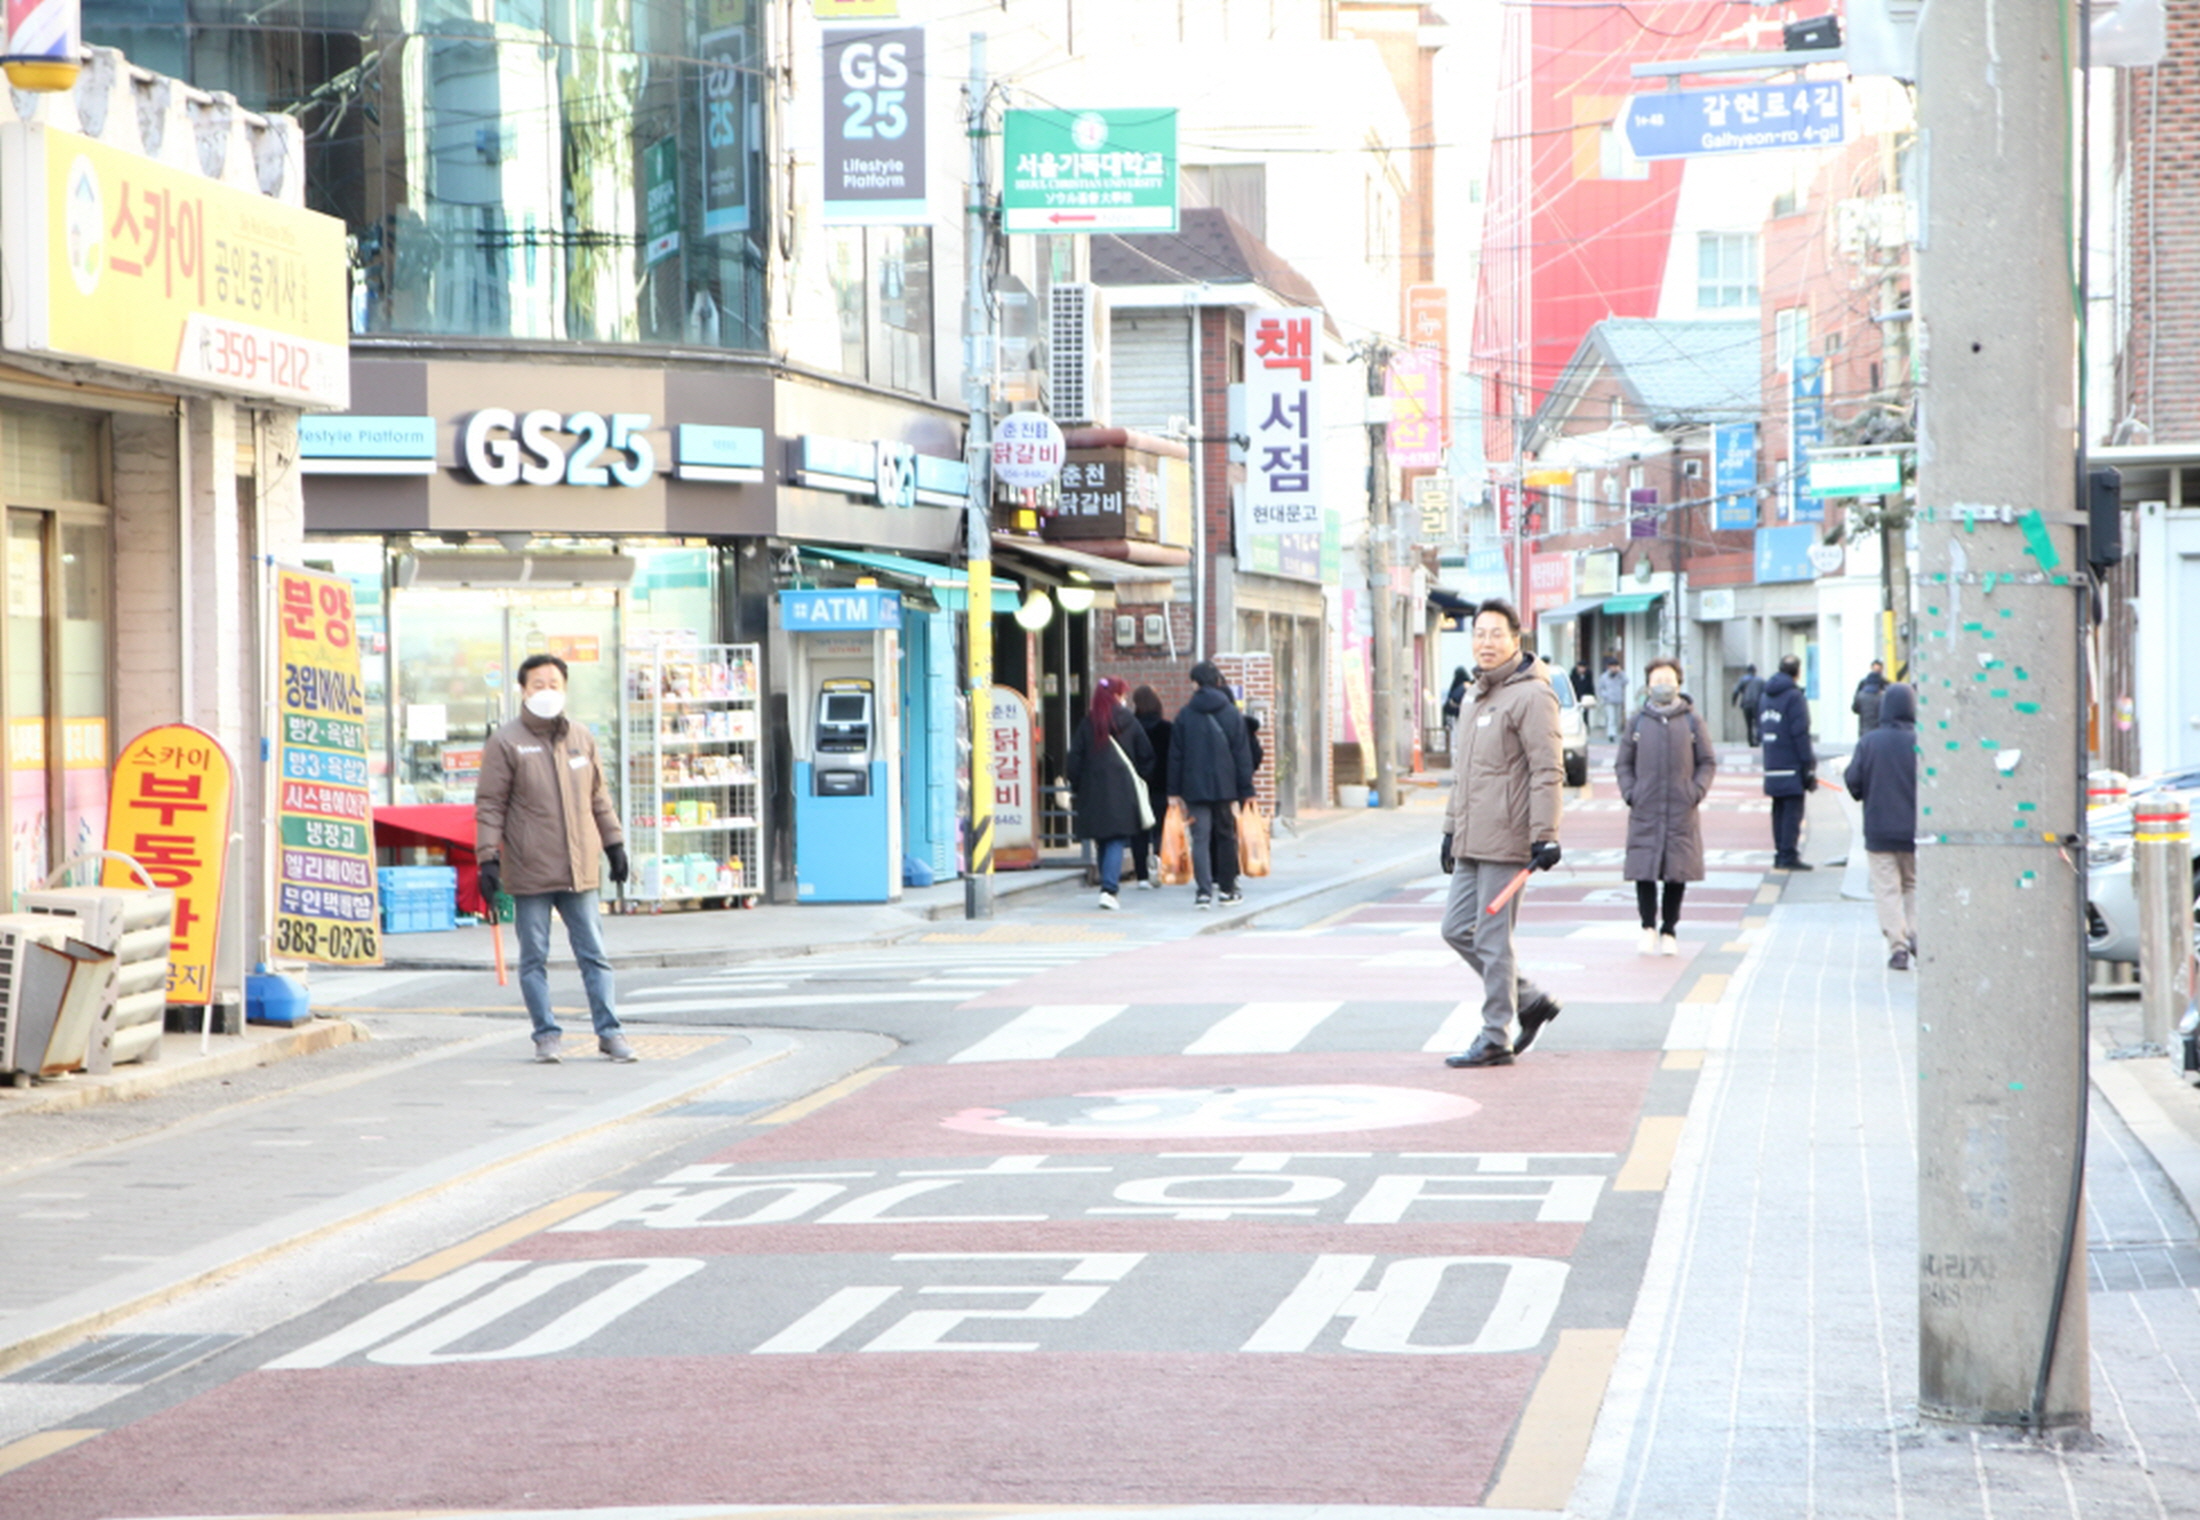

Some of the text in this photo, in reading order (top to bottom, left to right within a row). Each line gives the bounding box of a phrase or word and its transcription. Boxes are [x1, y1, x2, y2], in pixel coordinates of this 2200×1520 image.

[839, 42, 908, 89] GS
[841, 90, 908, 139] 25
[1702, 124, 1839, 149] Galhyeon-ro 4-gil
[843, 158, 904, 174] Lifestyle
[843, 174, 905, 188] Platform
[1016, 152, 1165, 178] 서울기독대학교
[108, 180, 206, 307] 스카이
[214, 238, 298, 320] 공인중개사
[214, 327, 311, 391] 359-1212
[1253, 316, 1313, 382] 책
[299, 429, 425, 447] estyle Platform
[466, 407, 655, 488] GS25
[992, 442, 1058, 465] 닭갈비
[1258, 388, 1311, 494] 서점
[1063, 463, 1105, 487] 춘천
[1059, 491, 1121, 515] 닭갈비
[1252, 502, 1318, 525] 현대문고
[1419, 491, 1449, 532] 유리
[282, 576, 352, 649] 분양
[811, 597, 868, 622] ATM
[132, 746, 211, 771] 스카이
[993, 726, 1022, 808] 닭갈비
[307, 821, 355, 849] 냉장고
[285, 853, 368, 887] 엘리베이터
[277, 917, 377, 959] 383-0376
[558, 1151, 1616, 1233] 보호구역
[260, 1253, 1571, 1370] 어린이
